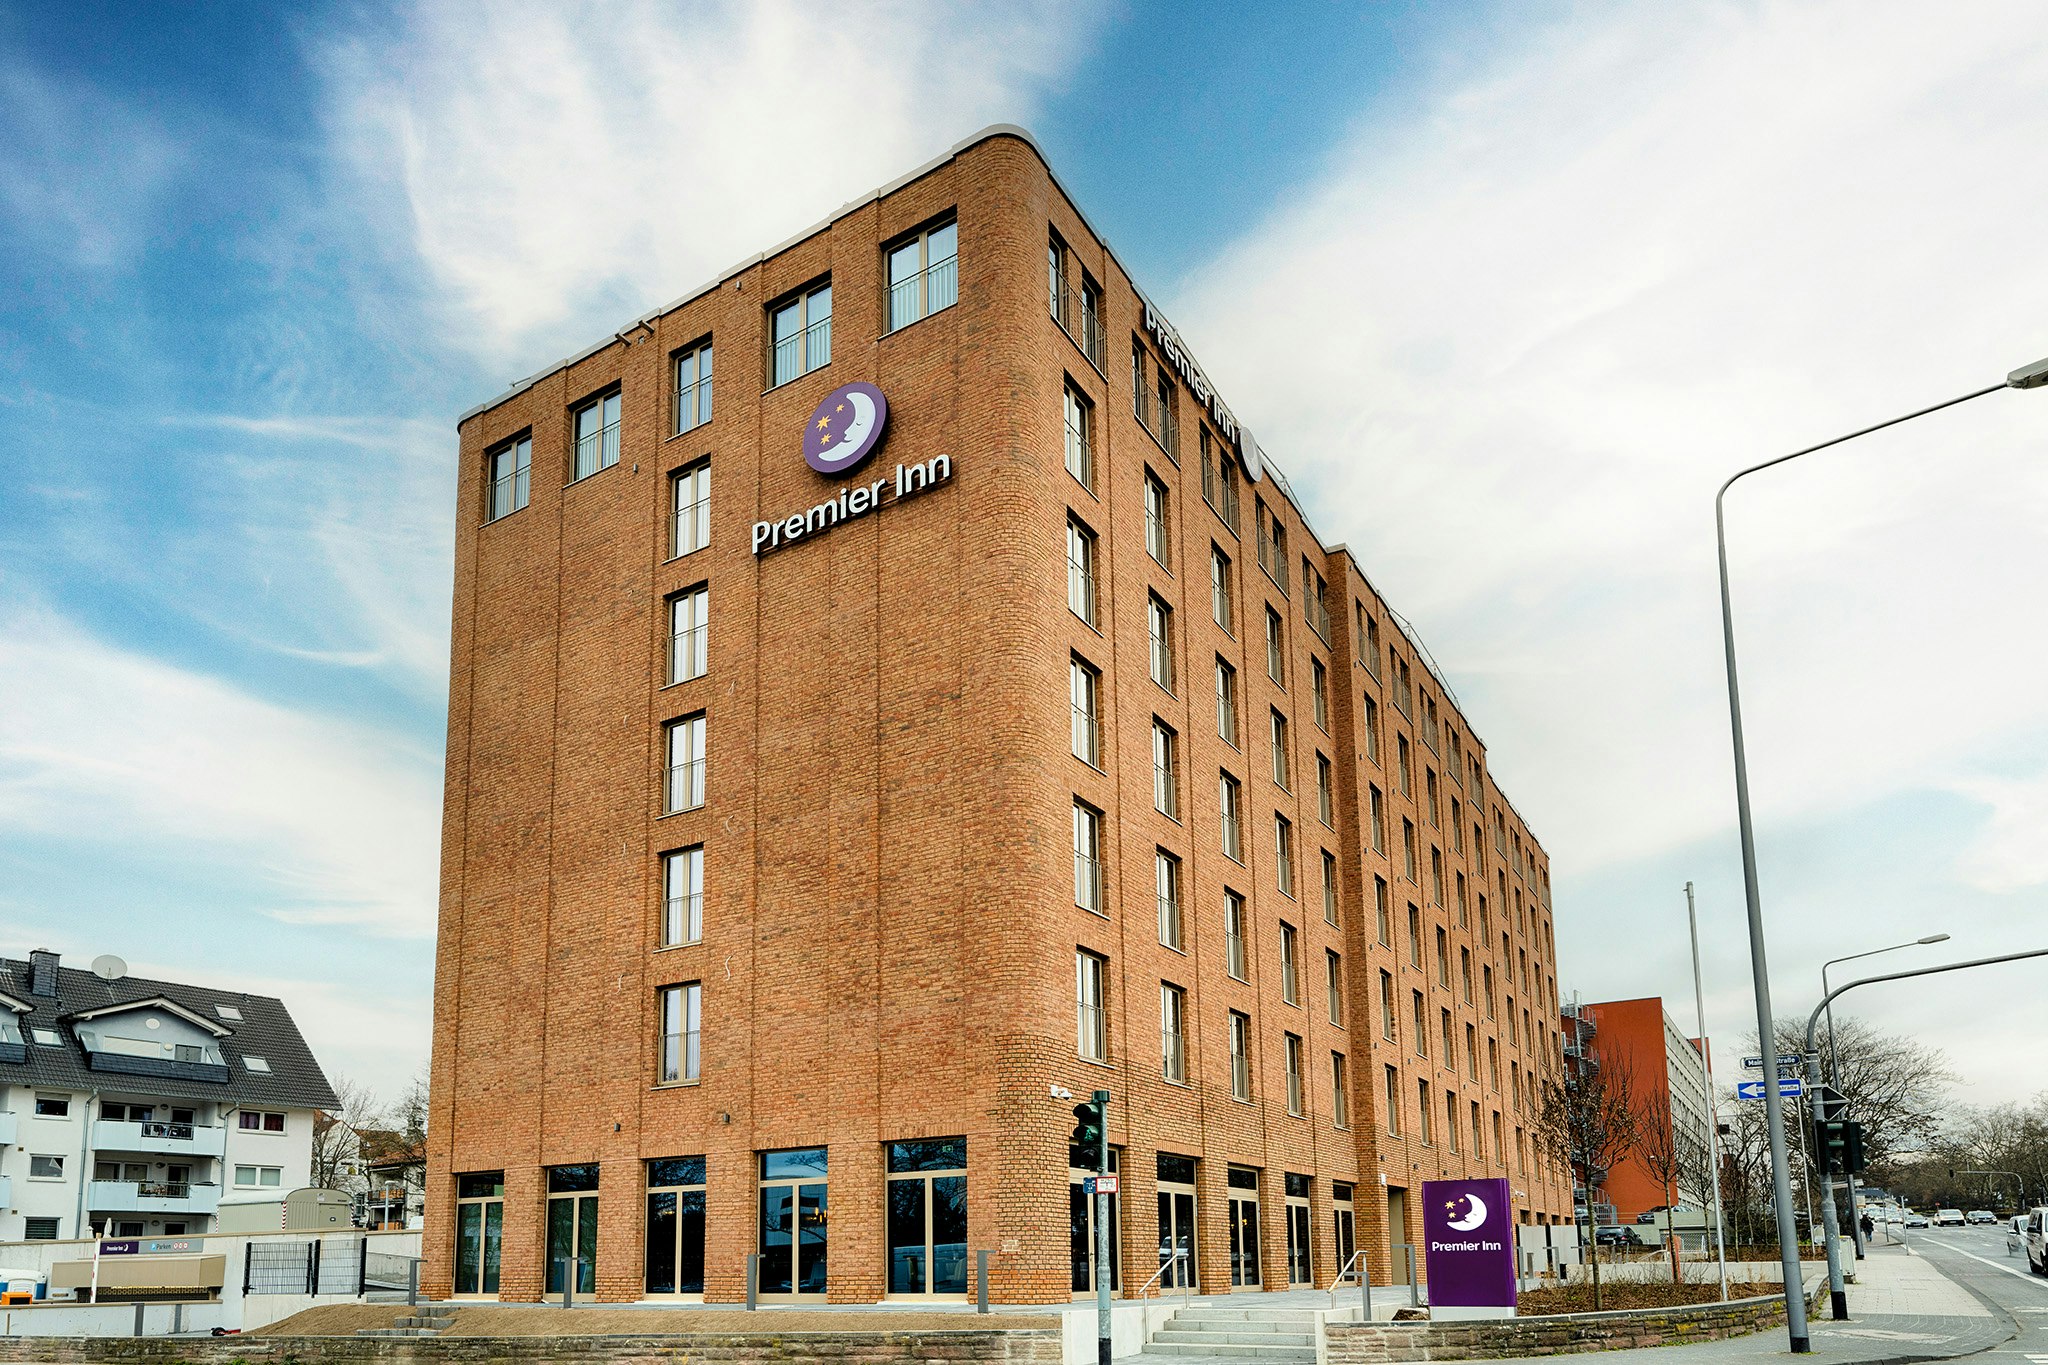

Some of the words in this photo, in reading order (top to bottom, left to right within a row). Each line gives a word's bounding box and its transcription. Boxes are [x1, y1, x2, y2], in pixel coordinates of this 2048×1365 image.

[1145, 301, 1211, 408] Premier
[1213, 393, 1236, 444] Inn
[752, 478, 886, 555] Premier
[896, 453, 951, 497] Inn
[1431, 1240, 1480, 1252] Premier
[1482, 1240, 1502, 1251] Inn
